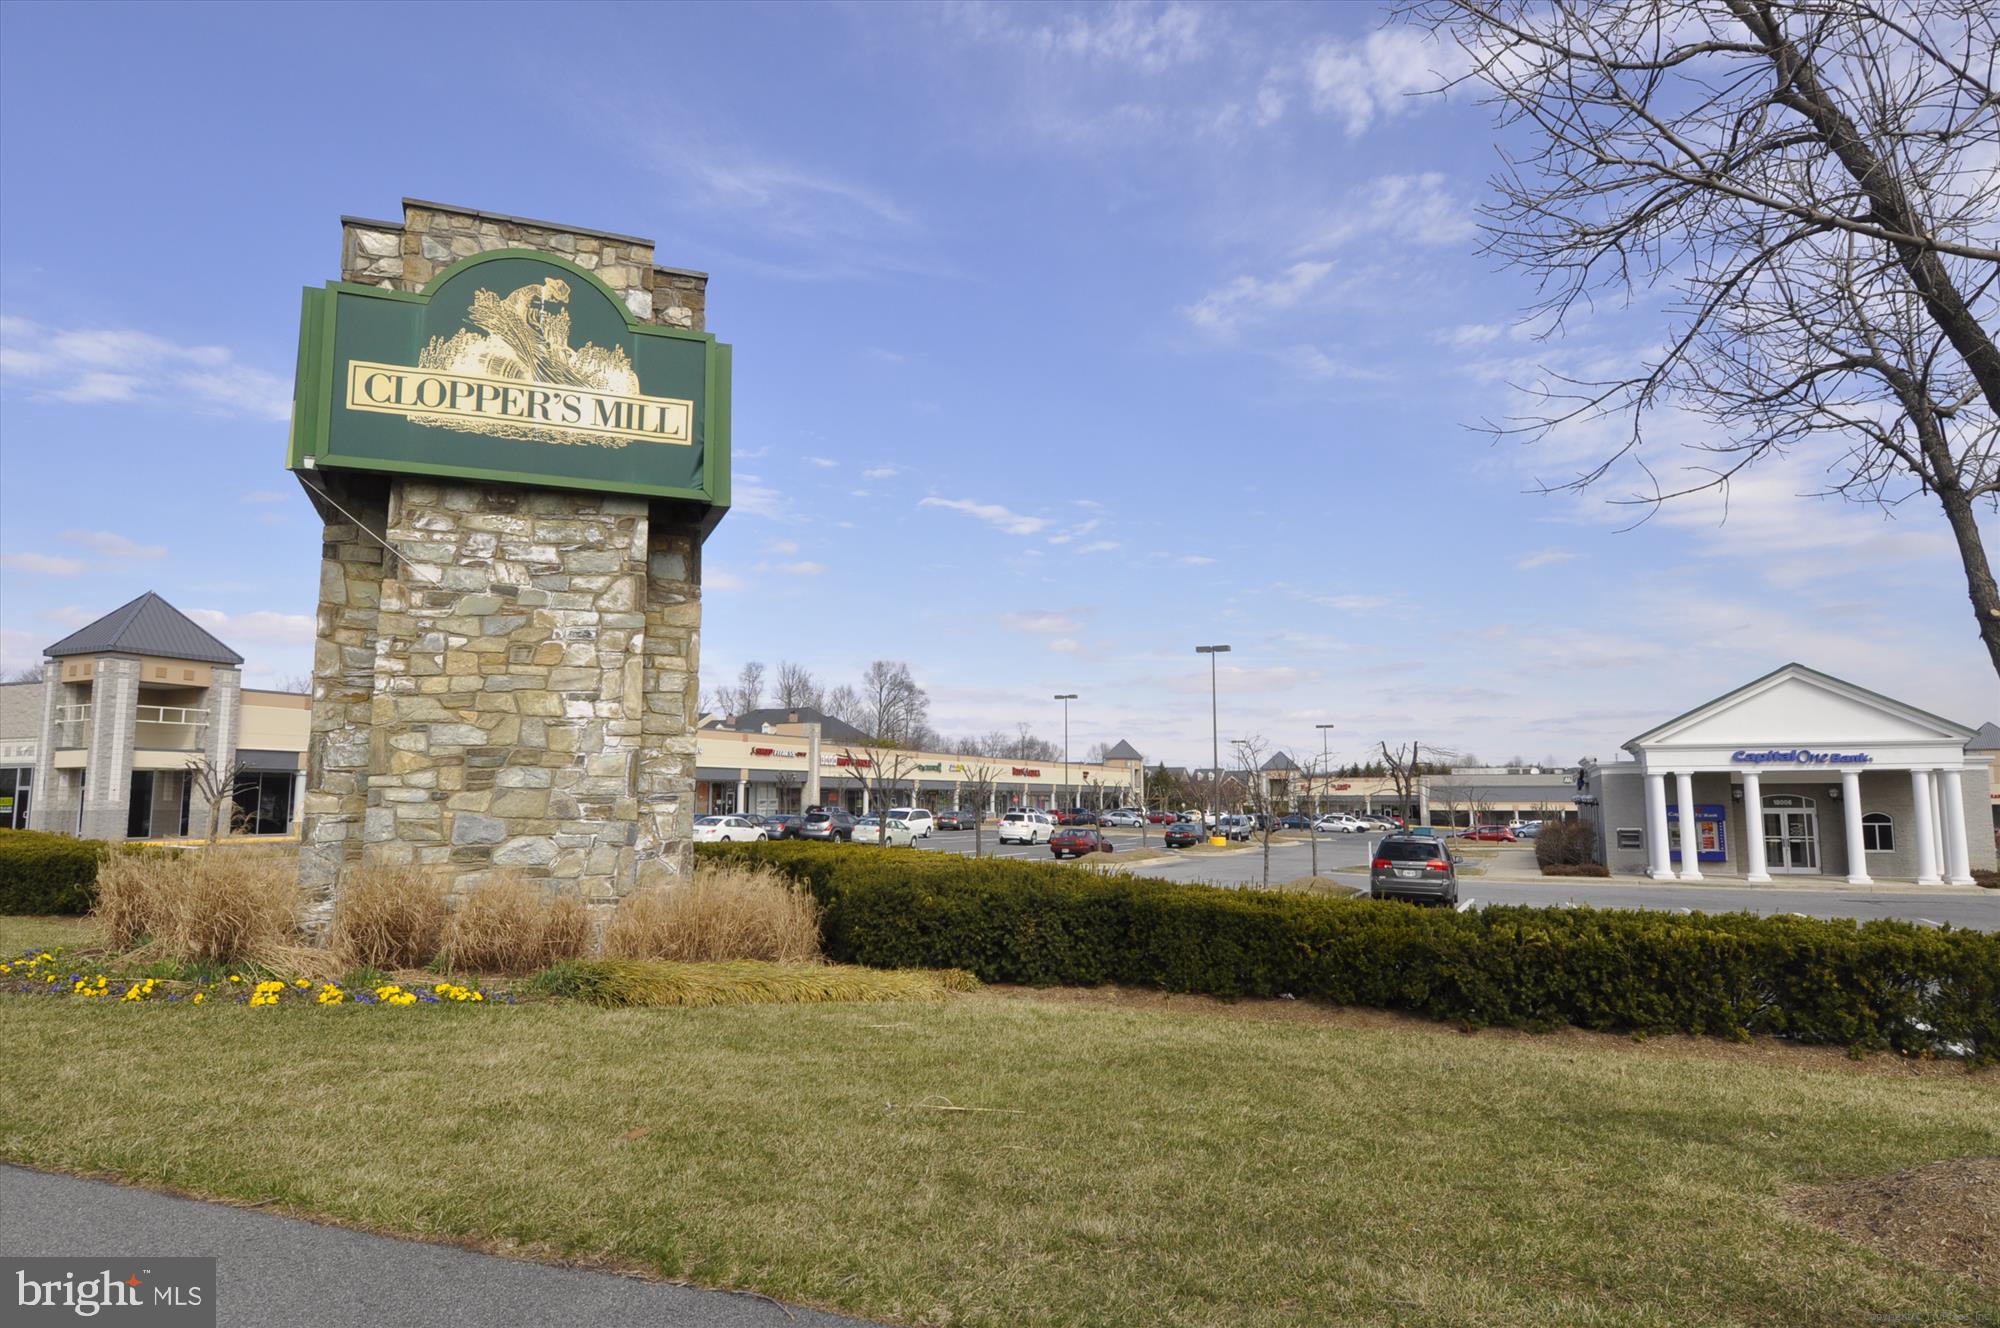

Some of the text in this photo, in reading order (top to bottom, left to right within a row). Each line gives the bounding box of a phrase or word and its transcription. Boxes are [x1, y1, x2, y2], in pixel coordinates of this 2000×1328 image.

[364, 373, 680, 436] CLOPPER'S MILL
[1731, 750, 1869, 764] Capital One Bank
